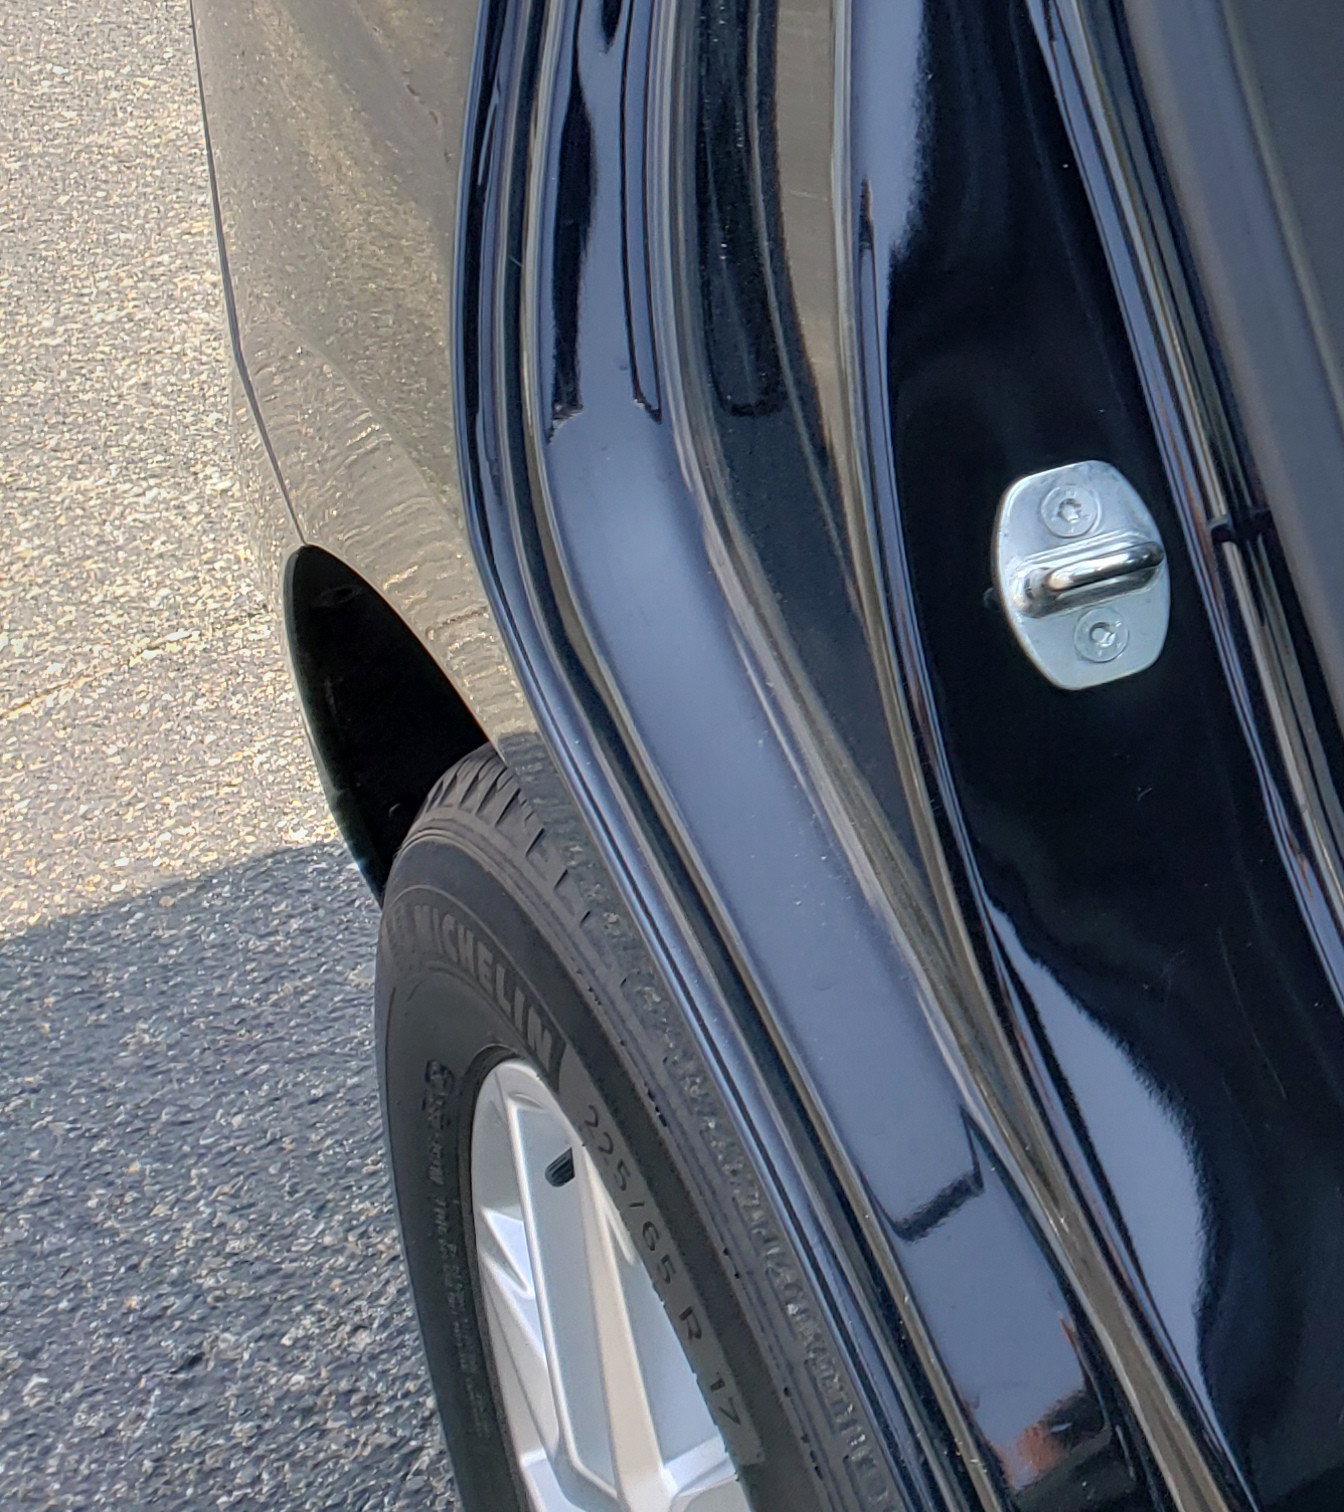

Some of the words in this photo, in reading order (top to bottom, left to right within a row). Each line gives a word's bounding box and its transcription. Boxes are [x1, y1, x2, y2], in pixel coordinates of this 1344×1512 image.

[413, 903, 553, 1076] MICHELIN
[582, 1103, 676, 1285] 225/65
[678, 1305, 703, 1341] R
[709, 1377, 742, 1426] 17
